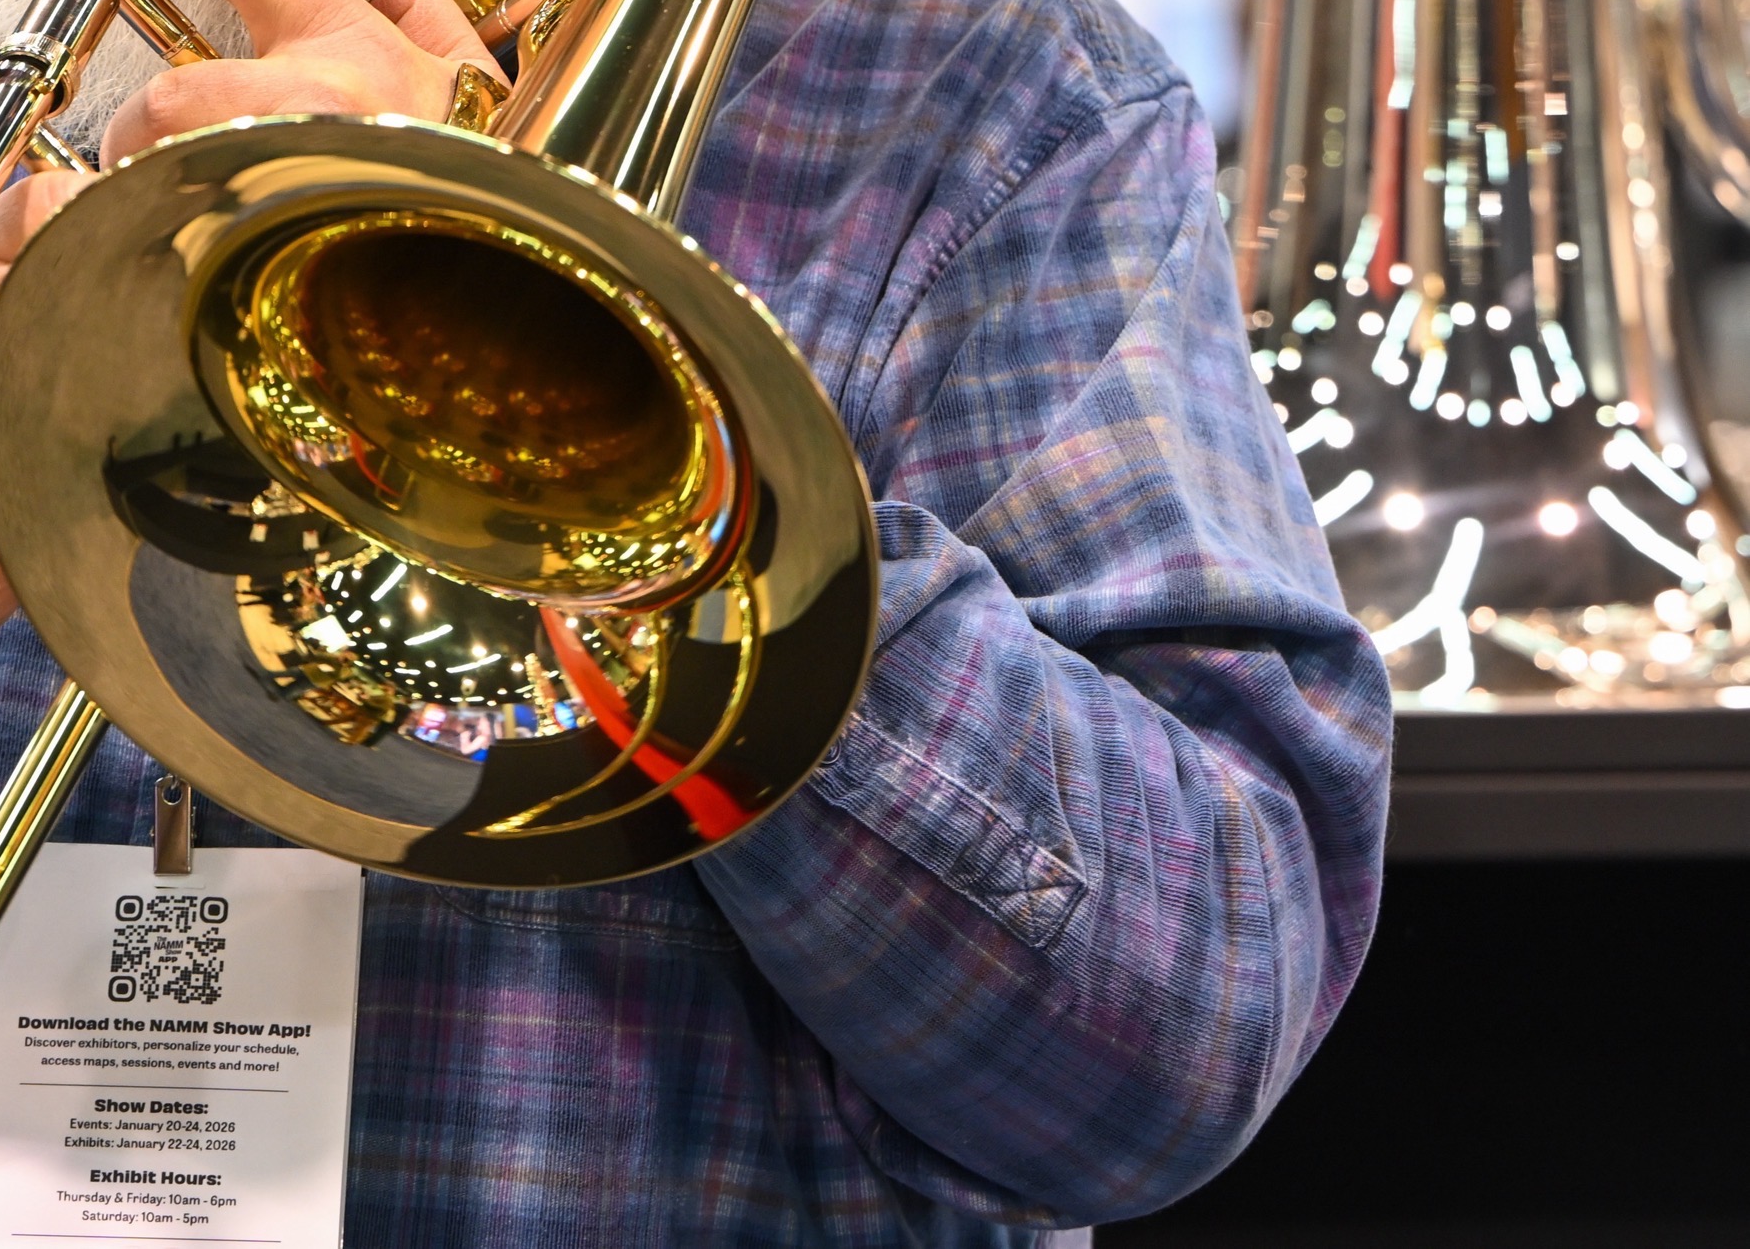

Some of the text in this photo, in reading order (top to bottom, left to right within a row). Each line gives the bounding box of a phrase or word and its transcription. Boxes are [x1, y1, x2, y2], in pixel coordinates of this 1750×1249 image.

[154, 940, 183, 950] NAMM
[18, 1017, 311, 1039] Download the NAMM Show App!
[25, 1037, 299, 1056] Discover exhibitors, personalize your schedule,
[41, 1057, 279, 1072] access maps, sessions, events and more!
[94, 1099, 208, 1114] Show Dates:
[70, 1118, 235, 1133] Events: January 20-24, 2026
[65, 1136, 236, 1151] Exhibits: January 22-24, 2026
[90, 1170, 221, 1185] Exhibit Hours:
[57, 1191, 111, 1205] Thursday
[114, 1193, 123, 1203] &
[127, 1193, 166, 1206] Friday:
[169, 1194, 200, 1205] 10am
[210, 1195, 236, 1208] 6pm
[82, 1210, 138, 1224] Saturday:
[142, 1212, 173, 1222] 10am
[183, 1213, 209, 1226] 5pm
